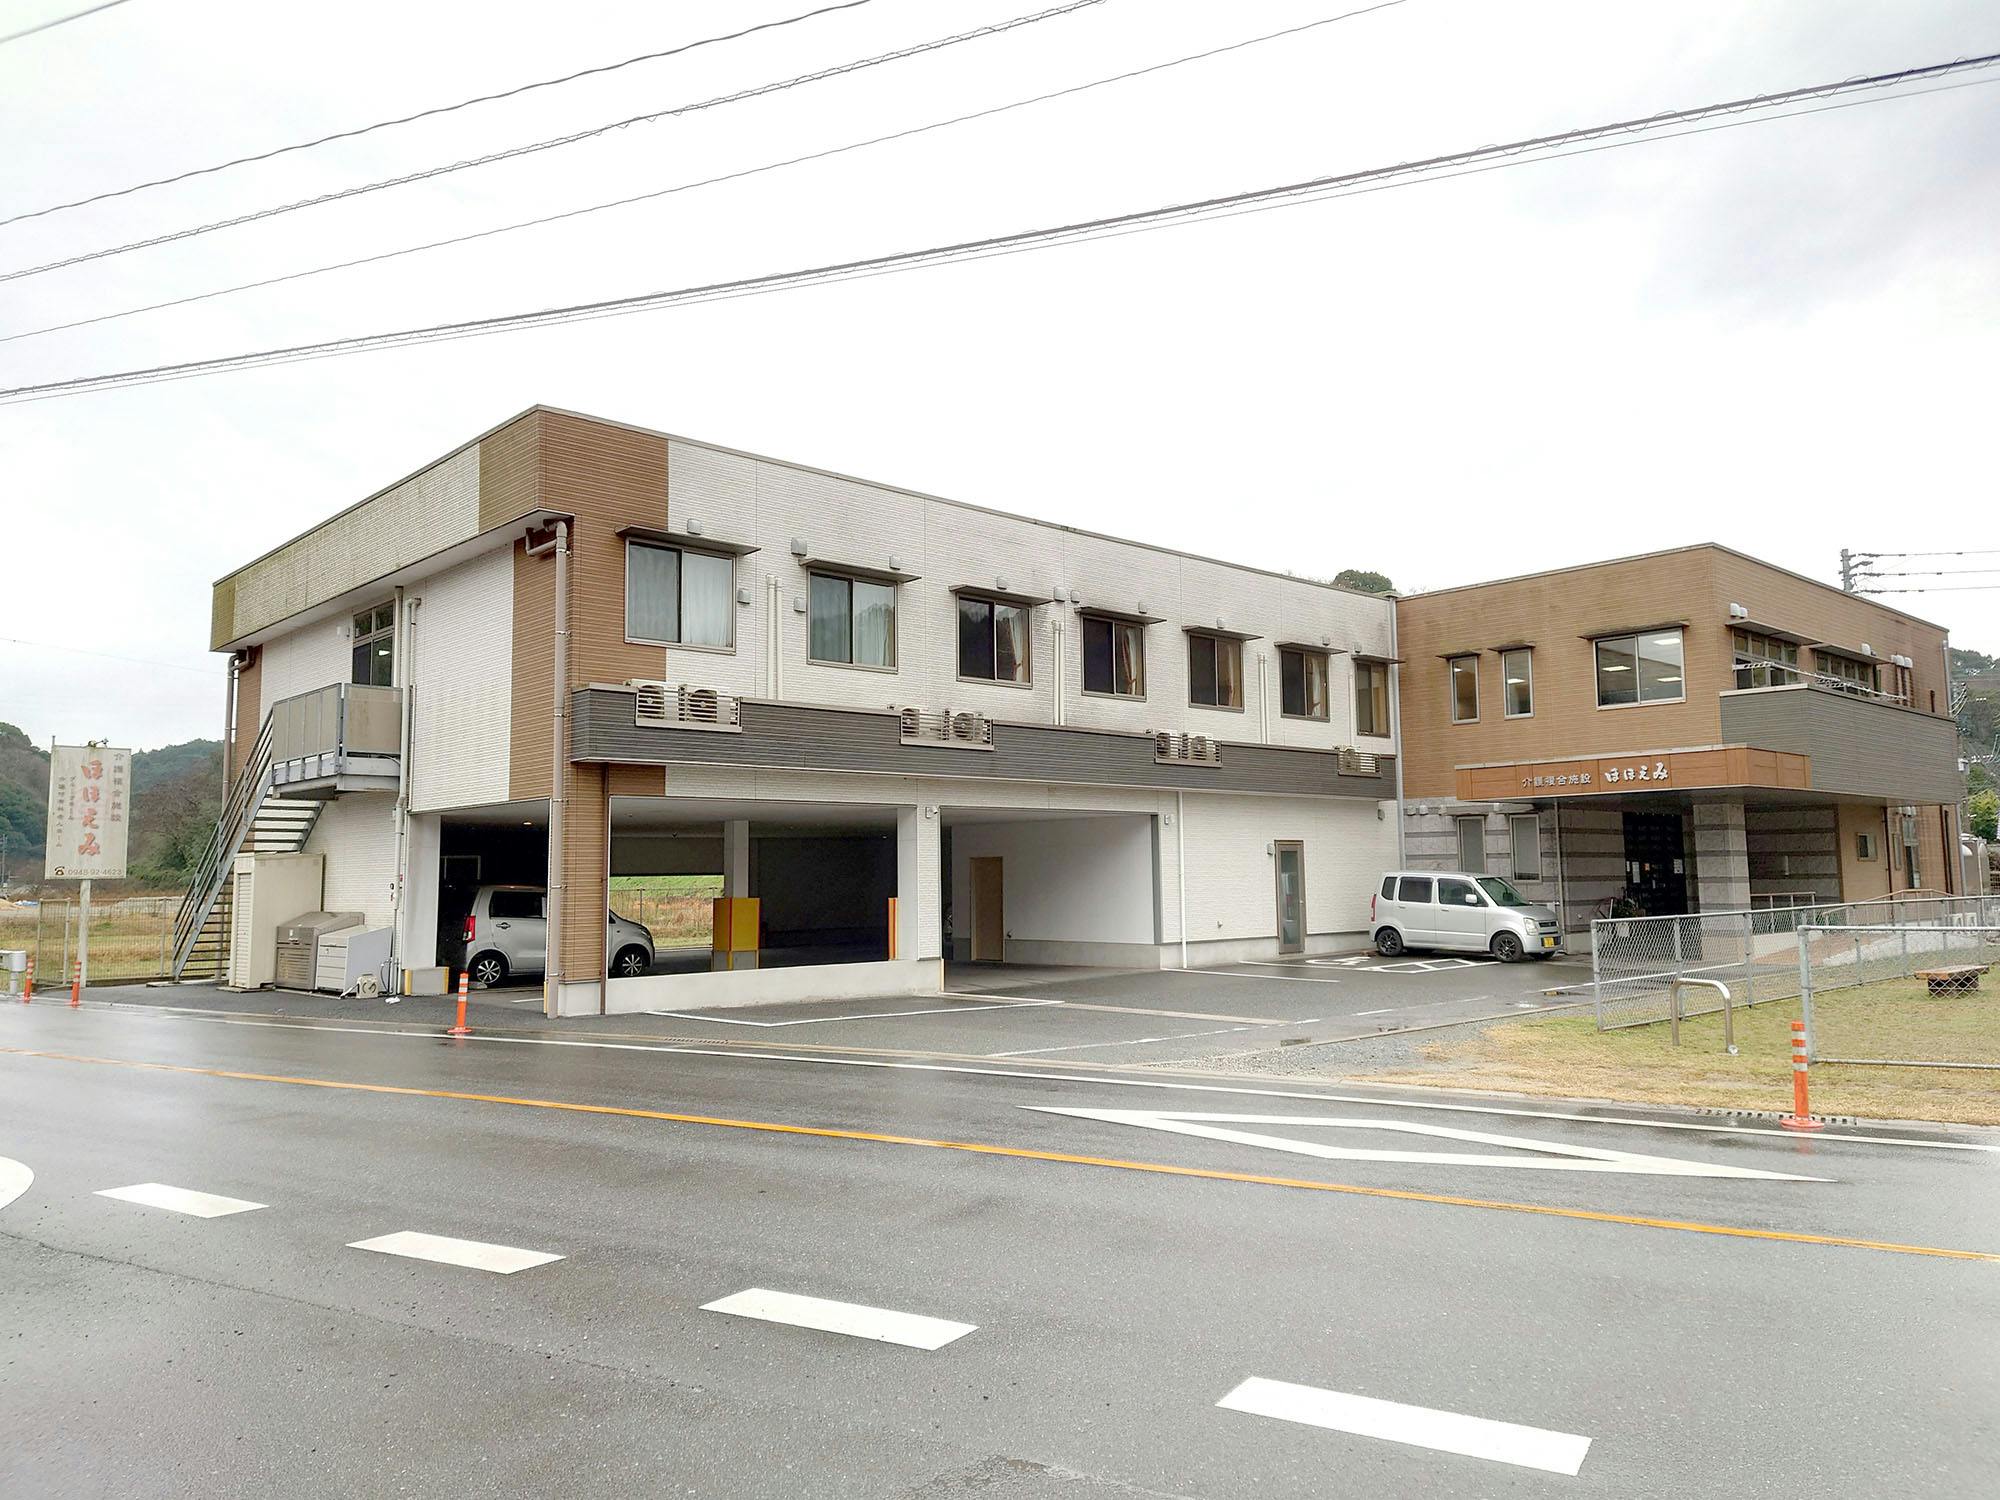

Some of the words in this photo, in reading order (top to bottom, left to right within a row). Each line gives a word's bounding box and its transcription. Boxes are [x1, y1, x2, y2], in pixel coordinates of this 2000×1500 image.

[1522, 773, 1592, 788] 介護複合施設
[1604, 761, 1669, 783] ほほえみ
[78, 760, 103, 856] ほほえみ
